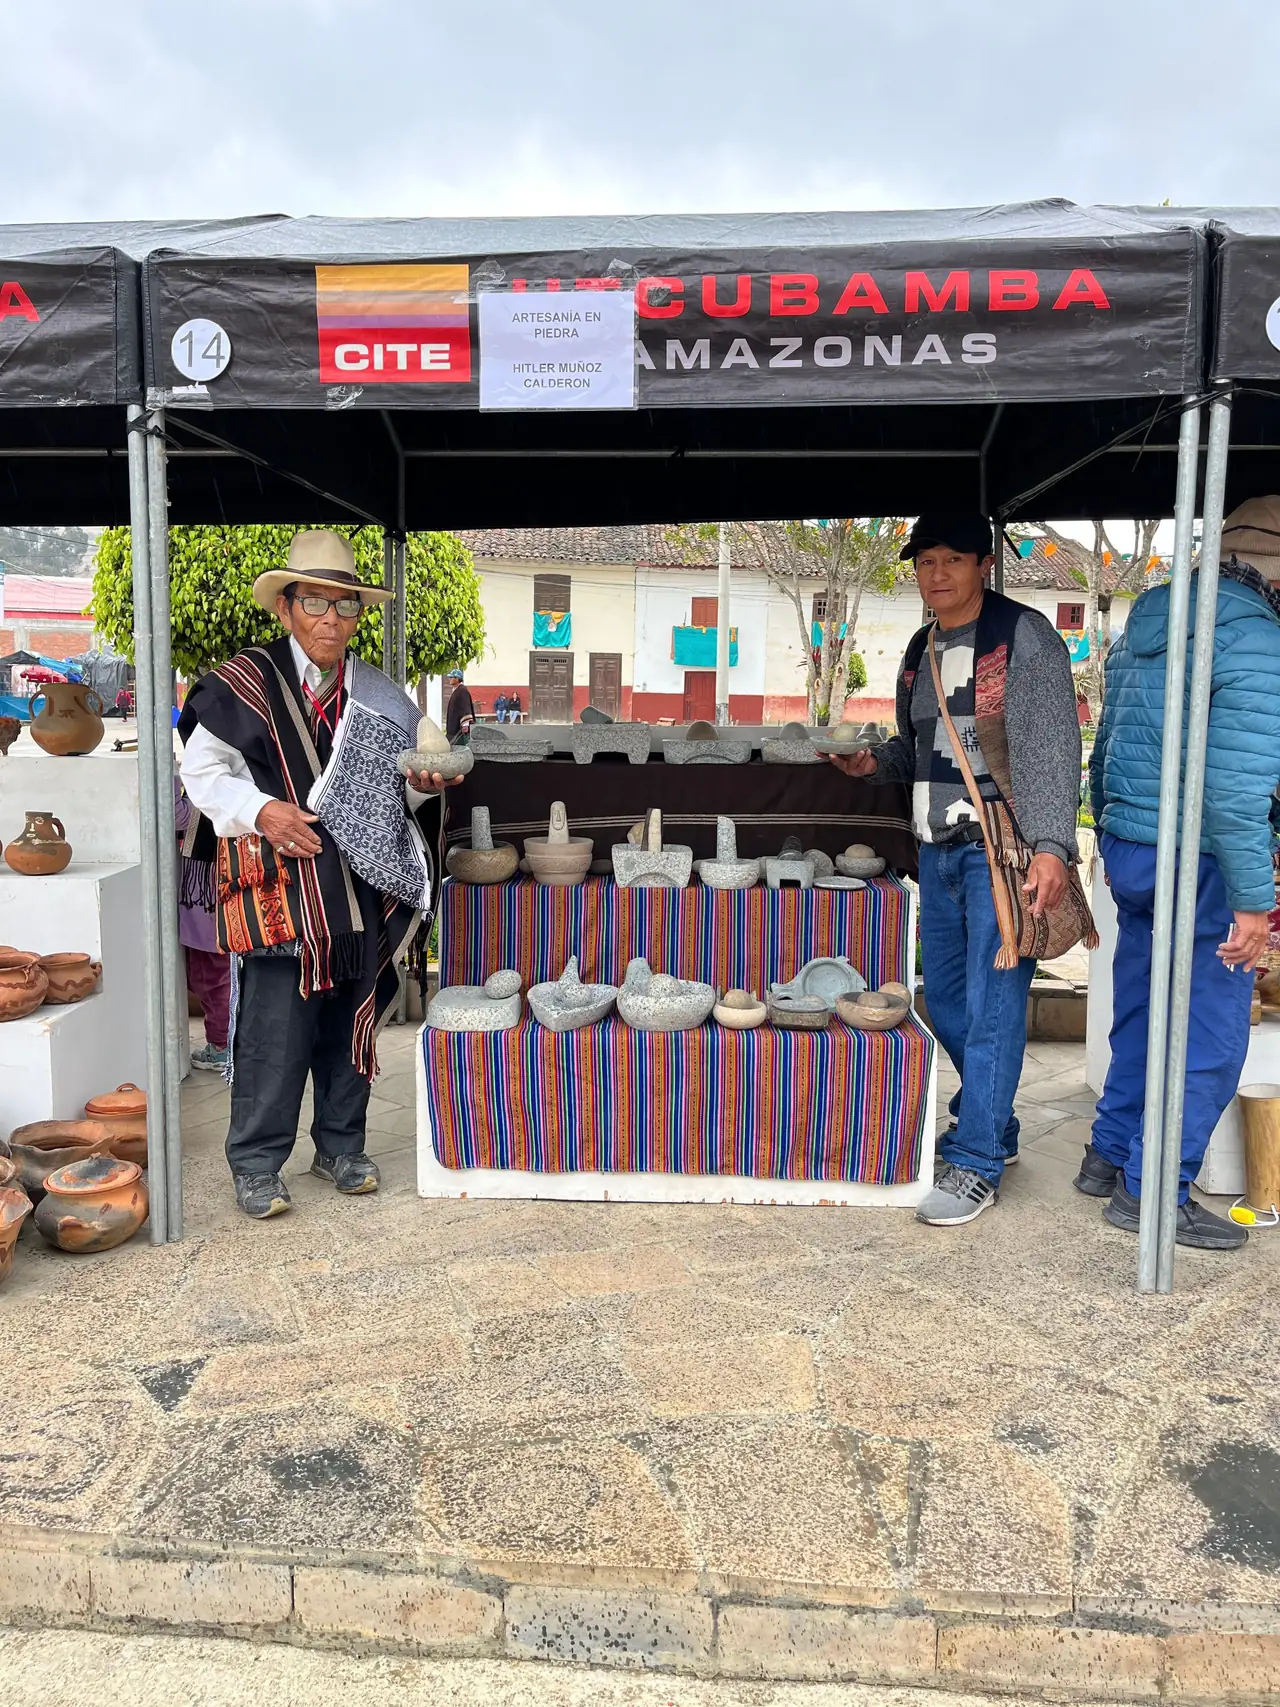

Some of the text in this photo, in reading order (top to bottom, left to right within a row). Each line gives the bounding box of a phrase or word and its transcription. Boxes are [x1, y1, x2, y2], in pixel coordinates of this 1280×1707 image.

[512, 310, 601, 322] ARTESANÍA EN
[534, 328, 579, 338] PIEDRA
[179, 330, 226, 369] 14
[334, 343, 451, 371] CITE
[513, 361, 602, 373] HITLER MUÑOZ
[524, 378, 590, 388] CALDERON
